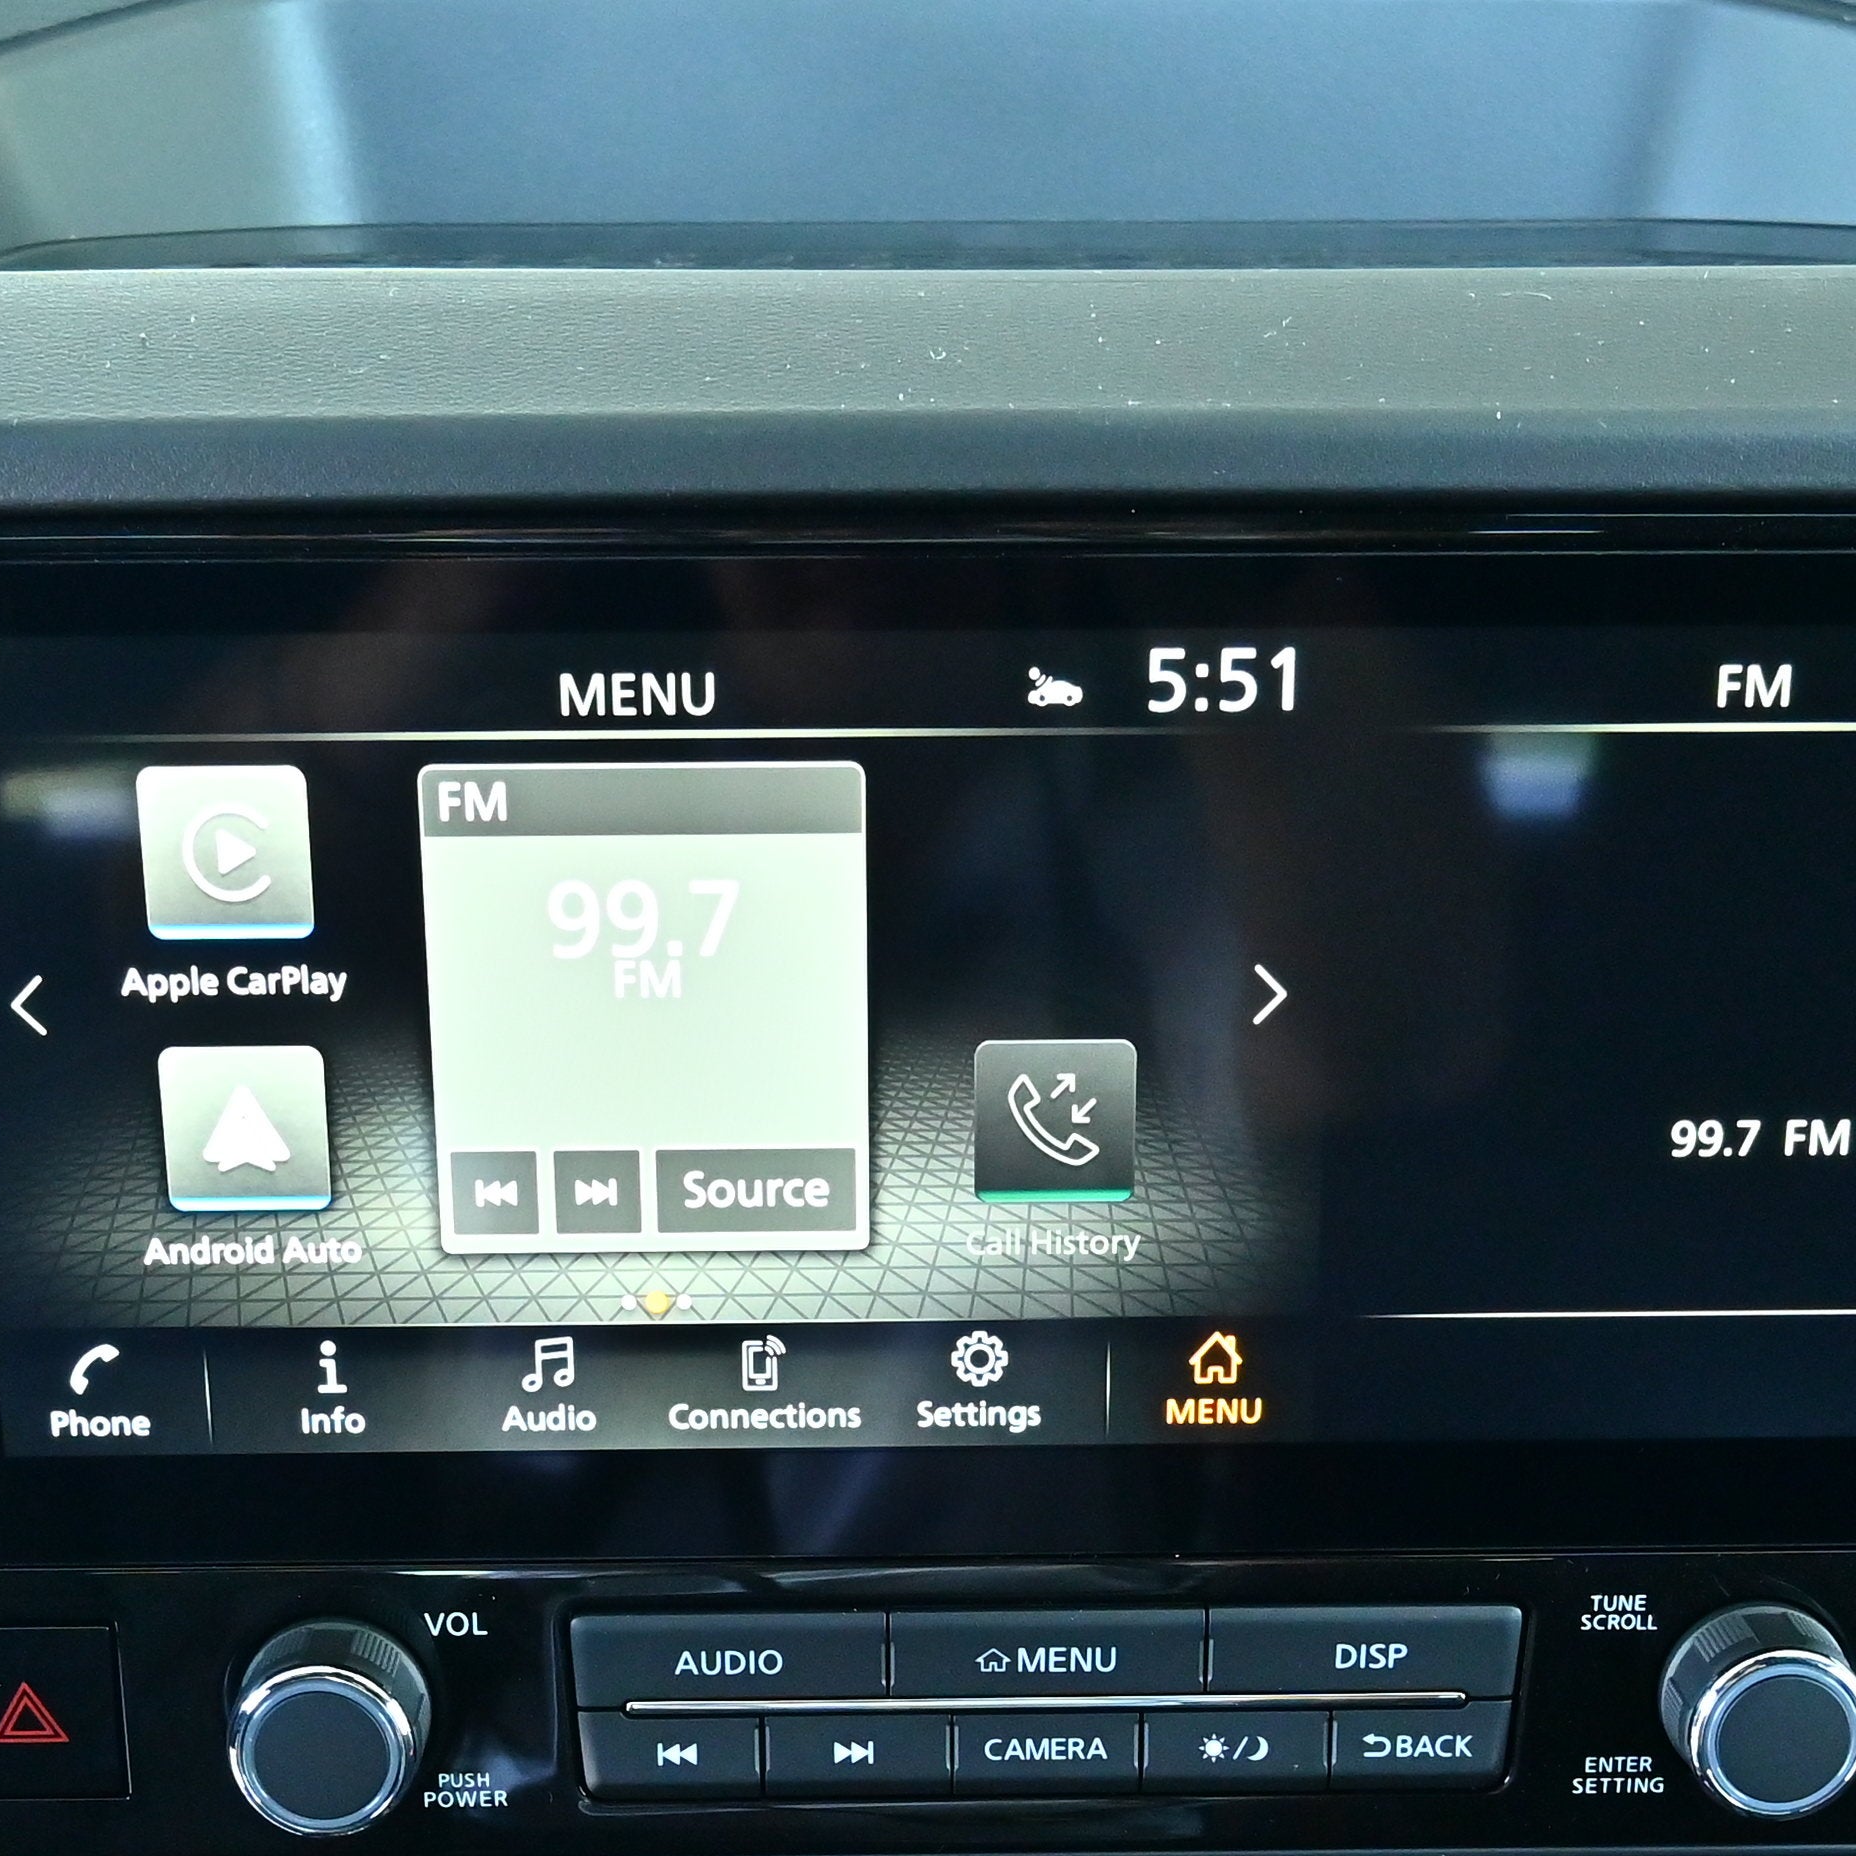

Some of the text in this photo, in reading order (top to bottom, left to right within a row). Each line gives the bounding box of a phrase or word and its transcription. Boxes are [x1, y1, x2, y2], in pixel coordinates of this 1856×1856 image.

[557, 671, 717, 718] MENU
[1147, 646, 1297, 713] 5:51
[1716, 664, 1793, 709] FM
[436, 780, 509, 823] FM
[546, 879, 741, 960] 99.7
[120, 965, 348, 1003] Apple CarPlay
[613, 959, 683, 1000] FM
[1670, 1118, 1852, 1158] 99.7 FM
[682, 1169, 831, 1210] Source
[143, 1236, 363, 1268] Android Auto
[965, 1227, 1142, 1262] Call History
[49, 1408, 151, 1439] Phone
[301, 1406, 367, 1436] Info
[502, 1404, 597, 1433] Audio
[667, 1401, 861, 1431] Connections
[916, 1400, 1042, 1433] Settings
[1165, 1397, 1263, 1426] MENU
[1590, 1594, 1648, 1612] TUNE
[423, 1611, 489, 1637] VOL
[1579, 1613, 1659, 1631] SCROLL
[674, 1649, 784, 1676] AUDIO
[1017, 1646, 1118, 1674] MENU
[1334, 1642, 1409, 1670] DISP
[983, 1736, 1109, 1762] CAMERA
[1395, 1734, 1473, 1759] BACK
[1584, 1756, 1653, 1774] ENTER
[438, 1772, 490, 1789] PUSH
[1571, 1777, 1665, 1795] SETTING
[423, 1789, 509, 1809] POWER
